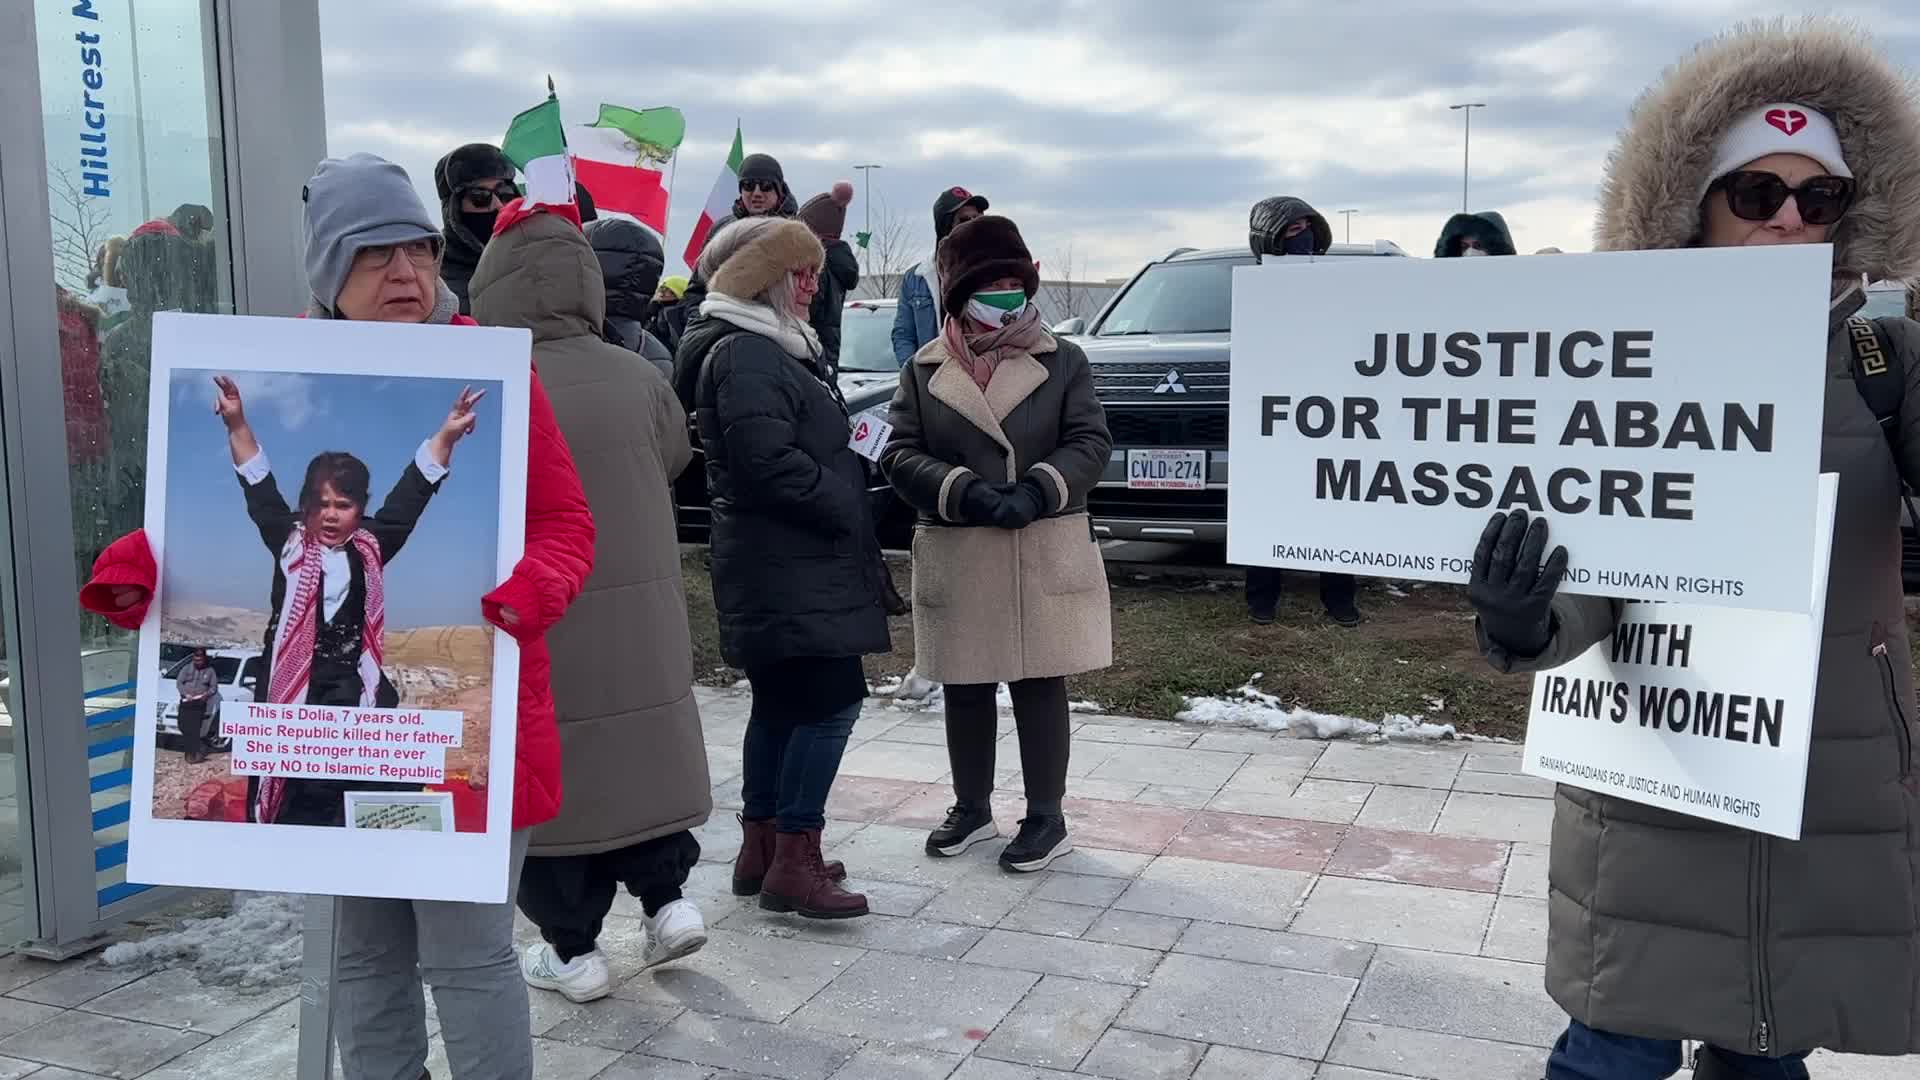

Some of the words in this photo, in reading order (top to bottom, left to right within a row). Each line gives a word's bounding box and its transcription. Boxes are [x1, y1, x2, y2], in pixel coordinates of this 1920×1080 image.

[75, 31, 110, 197] Hillcrest
[1354, 330, 1653, 378] JUSTICE
[1260, 395, 1380, 440] FOR
[1401, 397, 1537, 445] THE
[1558, 400, 1774, 453] ABAN
[1316, 458, 1695, 521] MASSACRE
[1272, 544, 1435, 570] IRANIAN-CANADIANS
[1440, 558, 1473, 574] FOR
[1597, 570, 1669, 590] HUMAN
[1676, 576, 1744, 597] RIGHTS
[1611, 623, 1693, 667] WITH
[222, 723, 272, 736] Islamic
[277, 725, 339, 740] Republic
[343, 728, 381, 741] killed
[385, 729, 409, 742] her
[413, 731, 459, 744] father.
[248, 705, 277, 719] This
[282, 707, 293, 720] is
[298, 708, 337, 723] Dolia,
[342, 710, 350, 722] 7
[354, 712, 394, 725] years
[399, 713, 425, 725] old.
[1541, 675, 1629, 724] IRAN'S
[1638, 685, 1785, 747] WOMEN
[233, 759, 246, 769] to
[251, 761, 276, 773] say
[280, 760, 302, 772] NO
[306, 761, 320, 772] to
[324, 762, 375, 776] Islamic
[379, 764, 442, 779] Republic
[246, 740, 273, 753] She
[277, 742, 288, 754] is
[294, 744, 354, 759] stronger
[358, 746, 389, 758] than
[393, 751, 426, 760] ever
[1538, 756, 1608, 783] IRANIAN-CANADIANS
[1609, 771, 1625, 787] FOR
[1626, 776, 1659, 796] JUSTICE
[1660, 783, 1681, 800] AND
[1683, 788, 1721, 809] HUMAN
[1723, 796, 1761, 818] RIGHTS
